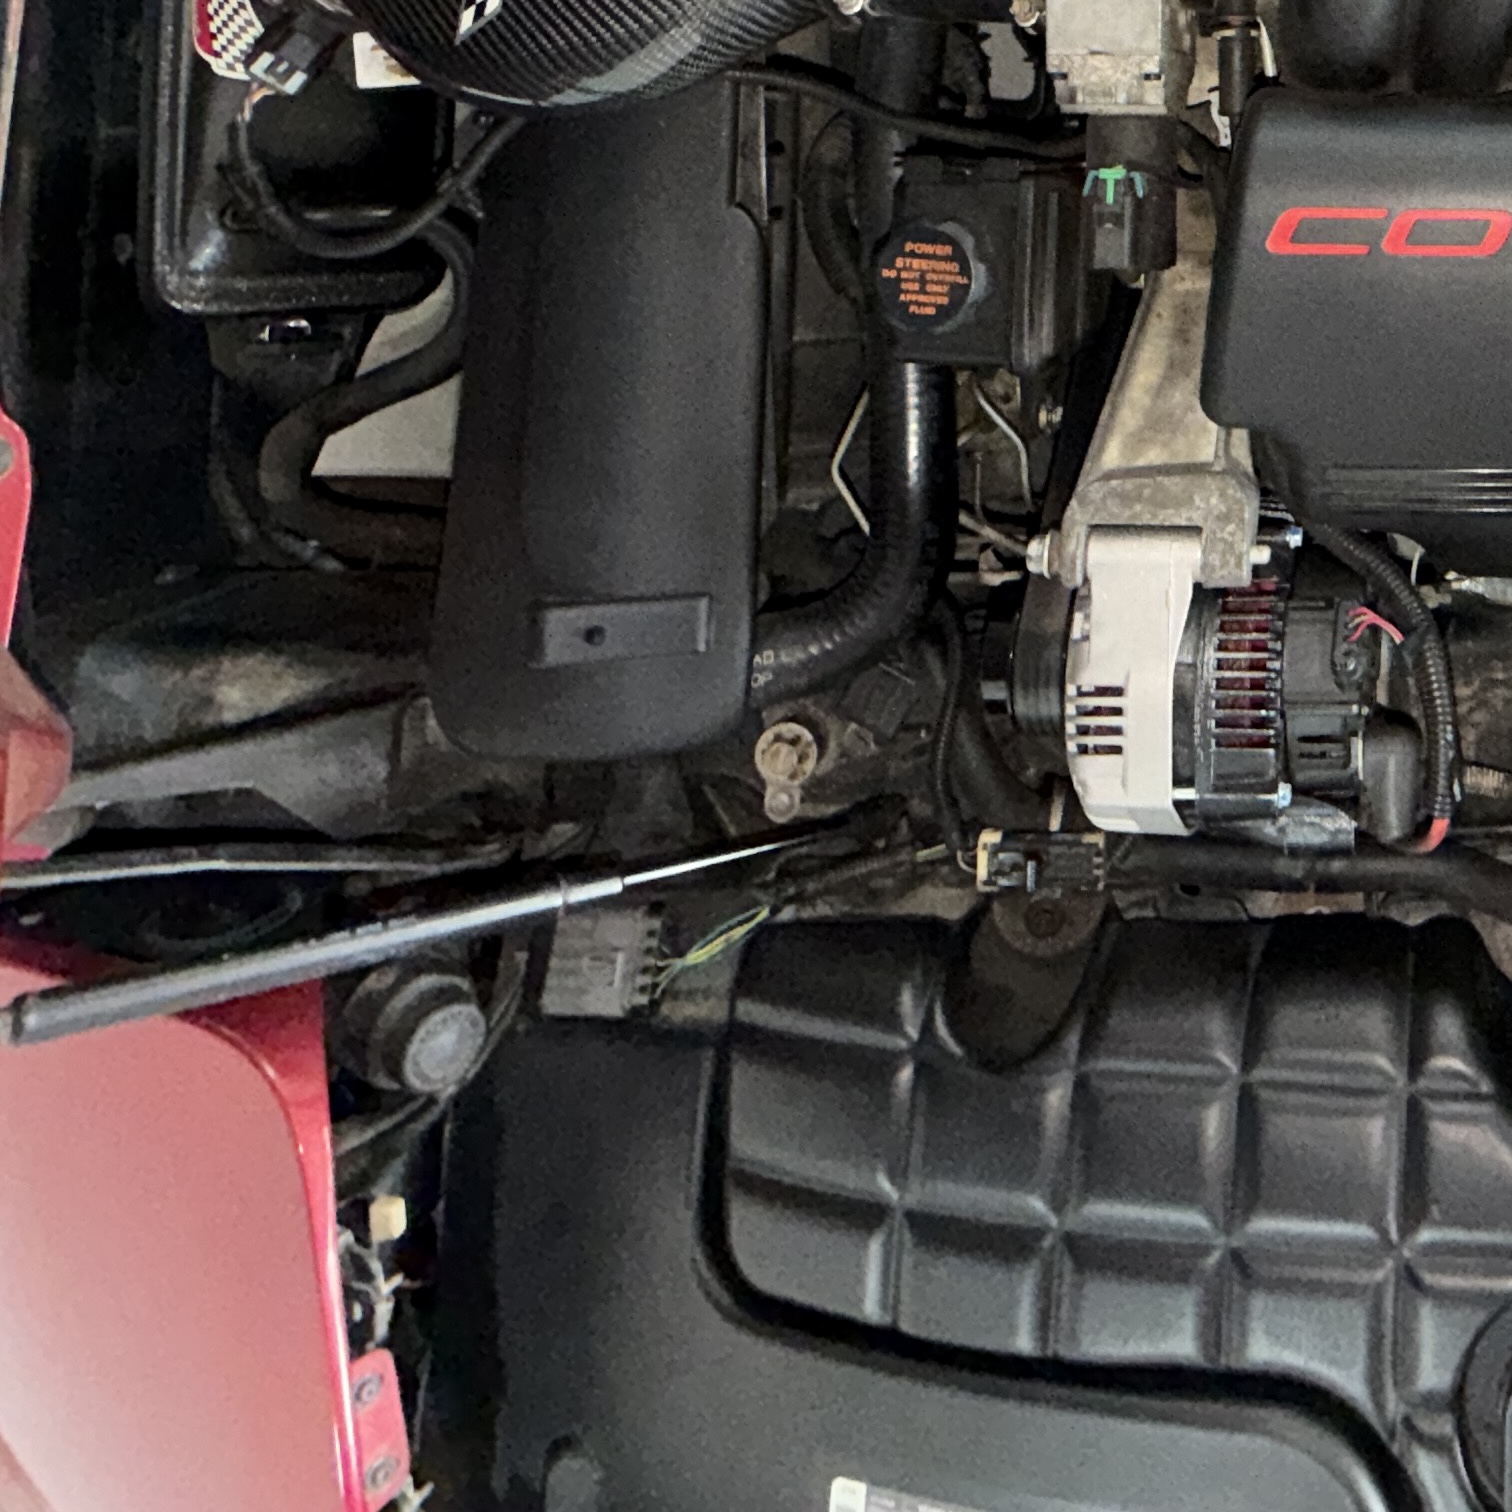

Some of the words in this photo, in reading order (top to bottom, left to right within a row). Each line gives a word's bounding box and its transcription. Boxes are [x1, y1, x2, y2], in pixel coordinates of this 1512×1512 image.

[904, 241, 952, 256] POWER
[895, 256, 960, 272] STEERING
[882, 268, 898, 278] DO
[900, 270, 920, 280] NOT
[908, 304, 936, 316] FLUID
